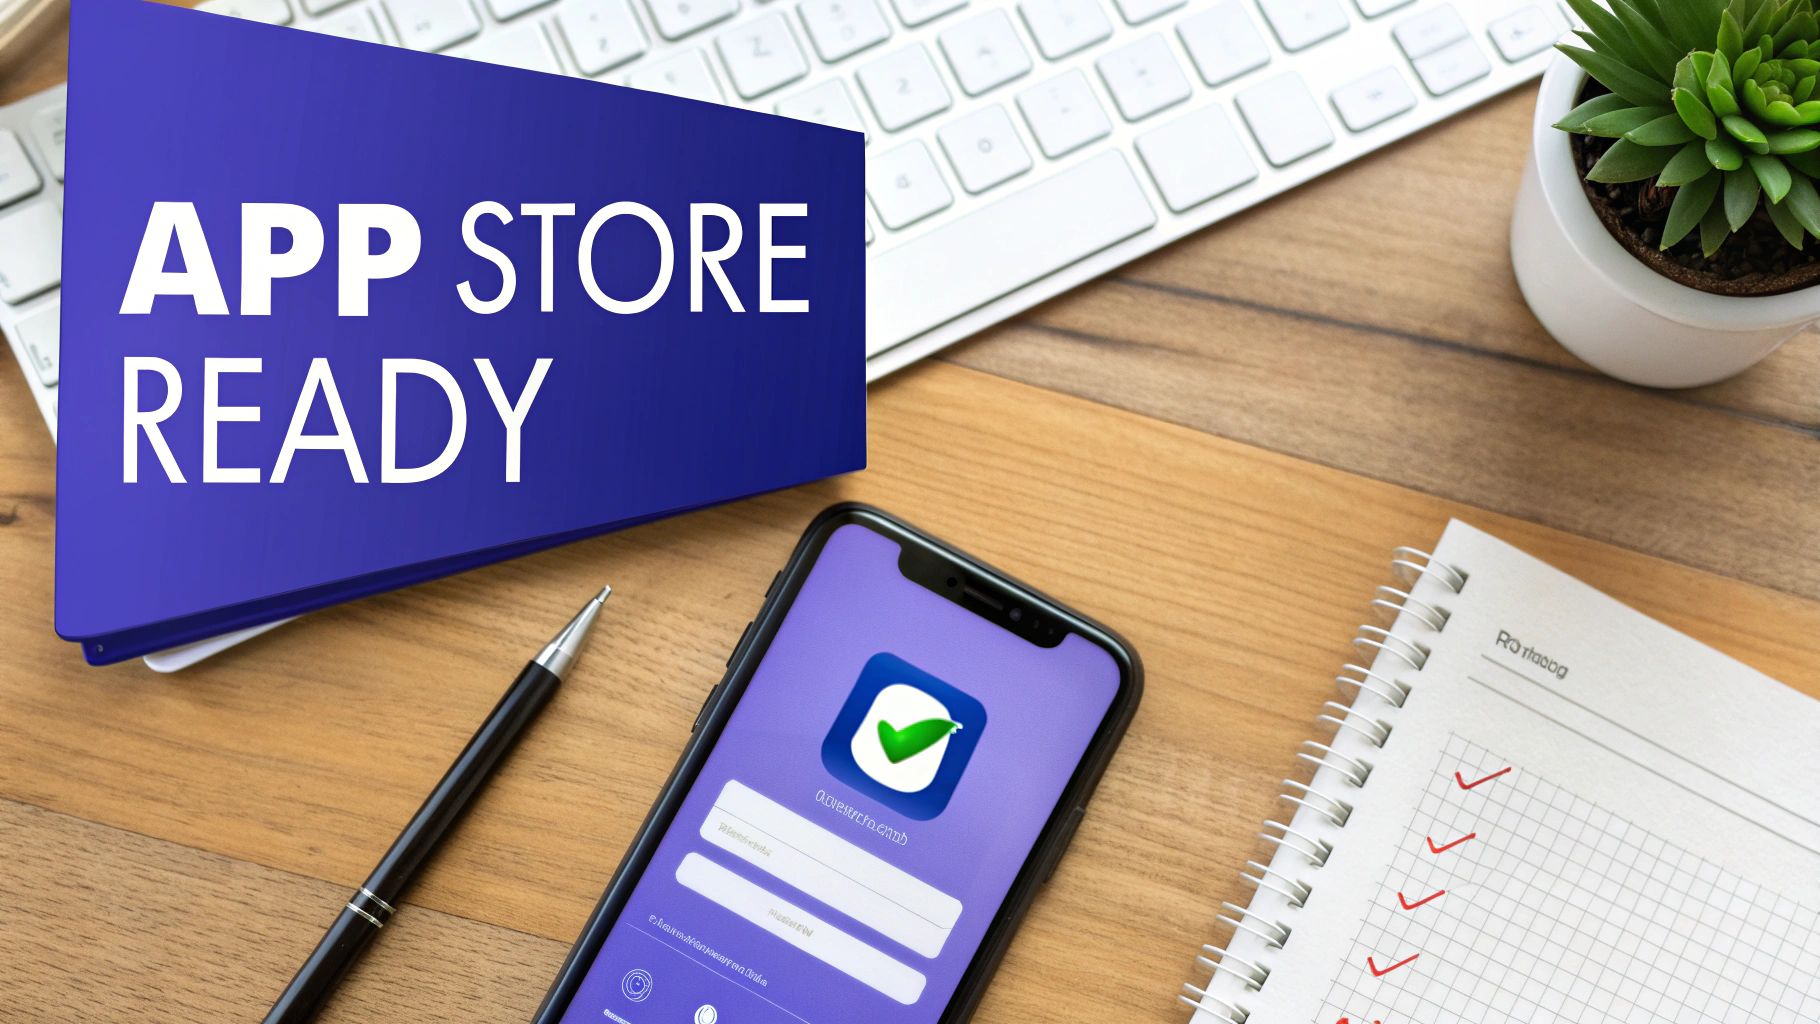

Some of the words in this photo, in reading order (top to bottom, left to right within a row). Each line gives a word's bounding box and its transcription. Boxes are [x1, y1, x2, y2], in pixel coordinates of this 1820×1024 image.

[119, 202, 421, 316] APP
[456, 201, 809, 314] STORE
[123, 357, 553, 483] READY
